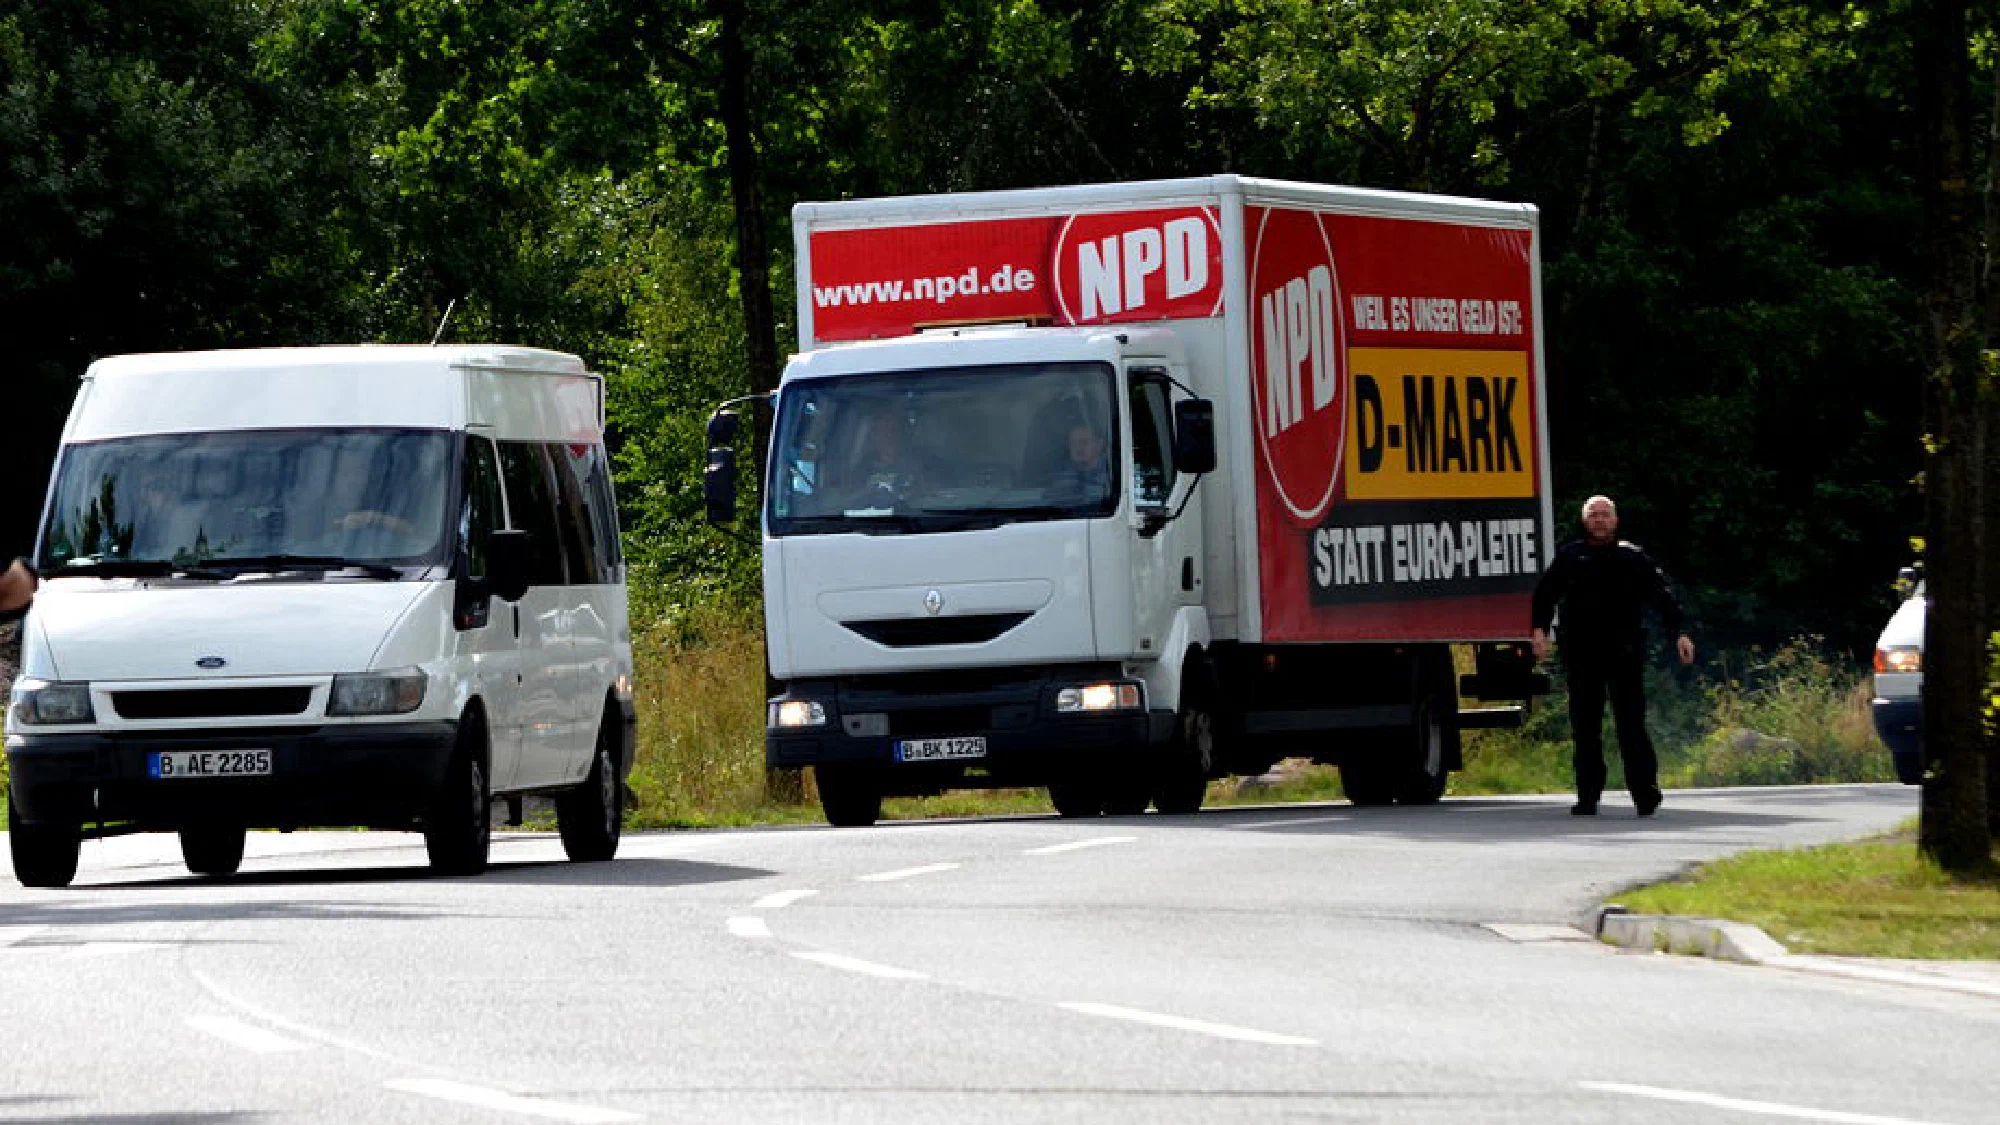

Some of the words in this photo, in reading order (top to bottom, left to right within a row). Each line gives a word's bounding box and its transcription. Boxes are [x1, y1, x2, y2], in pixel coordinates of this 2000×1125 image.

[814, 265, 1035, 307] www.npd.de
[1078, 217, 1209, 320] NPD
[1352, 296, 1388, 330] WEIL
[1390, 297, 1410, 331] ES
[1412, 297, 1459, 332] UNSER
[1460, 299, 1496, 333] GELD
[1261, 264, 1336, 438] NPD
[1354, 374, 1522, 473] D-MARK
[1315, 526, 1385, 587] STATT
[1391, 519, 1537, 582] EURO-PLEITE
[161, 756, 173, 775] B
[188, 753, 213, 773] AE
[217, 752, 269, 773] 2285
